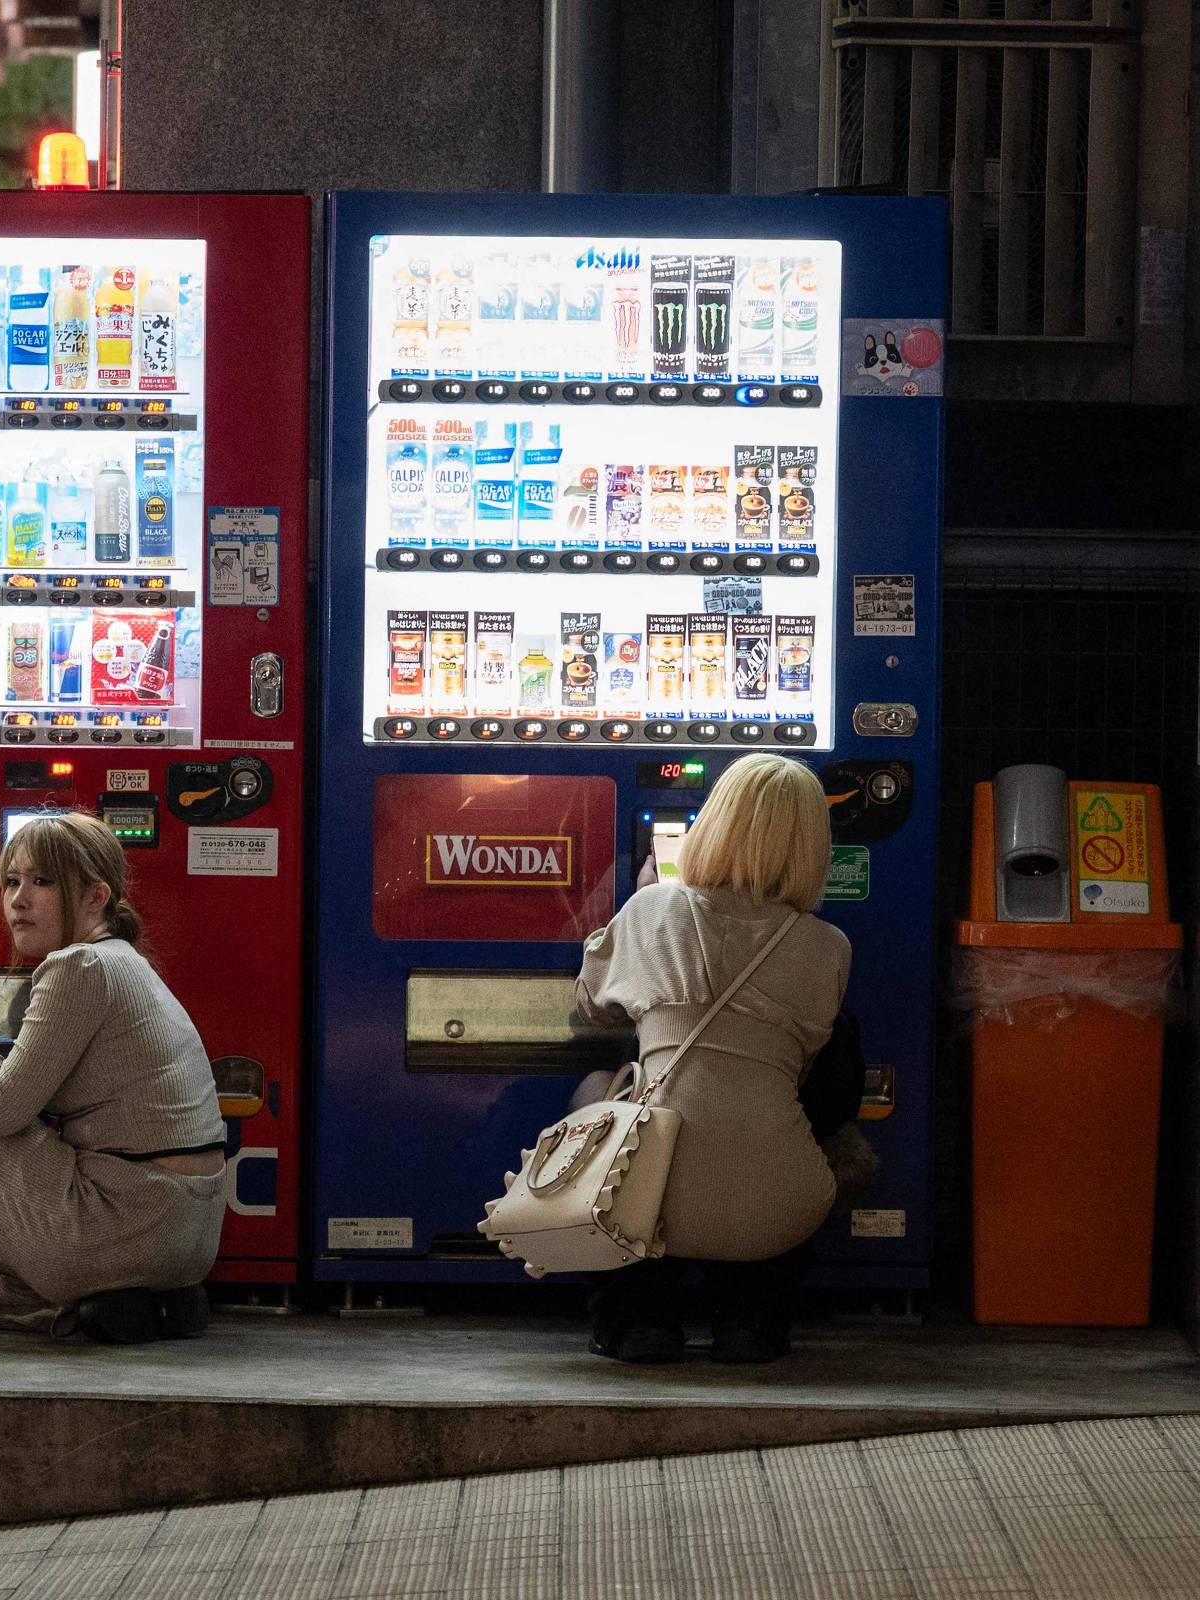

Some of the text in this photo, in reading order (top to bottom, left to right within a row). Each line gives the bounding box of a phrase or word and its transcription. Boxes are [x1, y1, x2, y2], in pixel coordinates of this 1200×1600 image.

[575, 245, 641, 270] Asahi
[13, 330, 47, 338] POCARI
[616, 388, 633, 396] 200
[659, 388, 676, 396] 200
[703, 388, 720, 396] 200
[793, 389, 807, 397] 120
[148, 401, 165, 410] 200
[388, 418, 426, 433] 500ml
[434, 420, 473, 434] 500ml
[390, 469, 425, 482] CALPIS
[435, 470, 470, 483] CALPIS
[391, 483, 424, 494] SODA
[435, 484, 468, 494] SODA
[56, 529, 82, 541] 天然水
[443, 553, 457, 562] 120
[487, 554, 501, 563] 150
[530, 554, 544, 563] 150
[617, 556, 630, 565] 120
[704, 556, 717, 565] 120
[62, 577, 77, 587] 120
[856, 624, 912, 633] 84-1973-01
[735, 638, 769, 692] BLACK
[660, 764, 681, 777] 120
[1103, 896, 1145, 908] Otsuka
